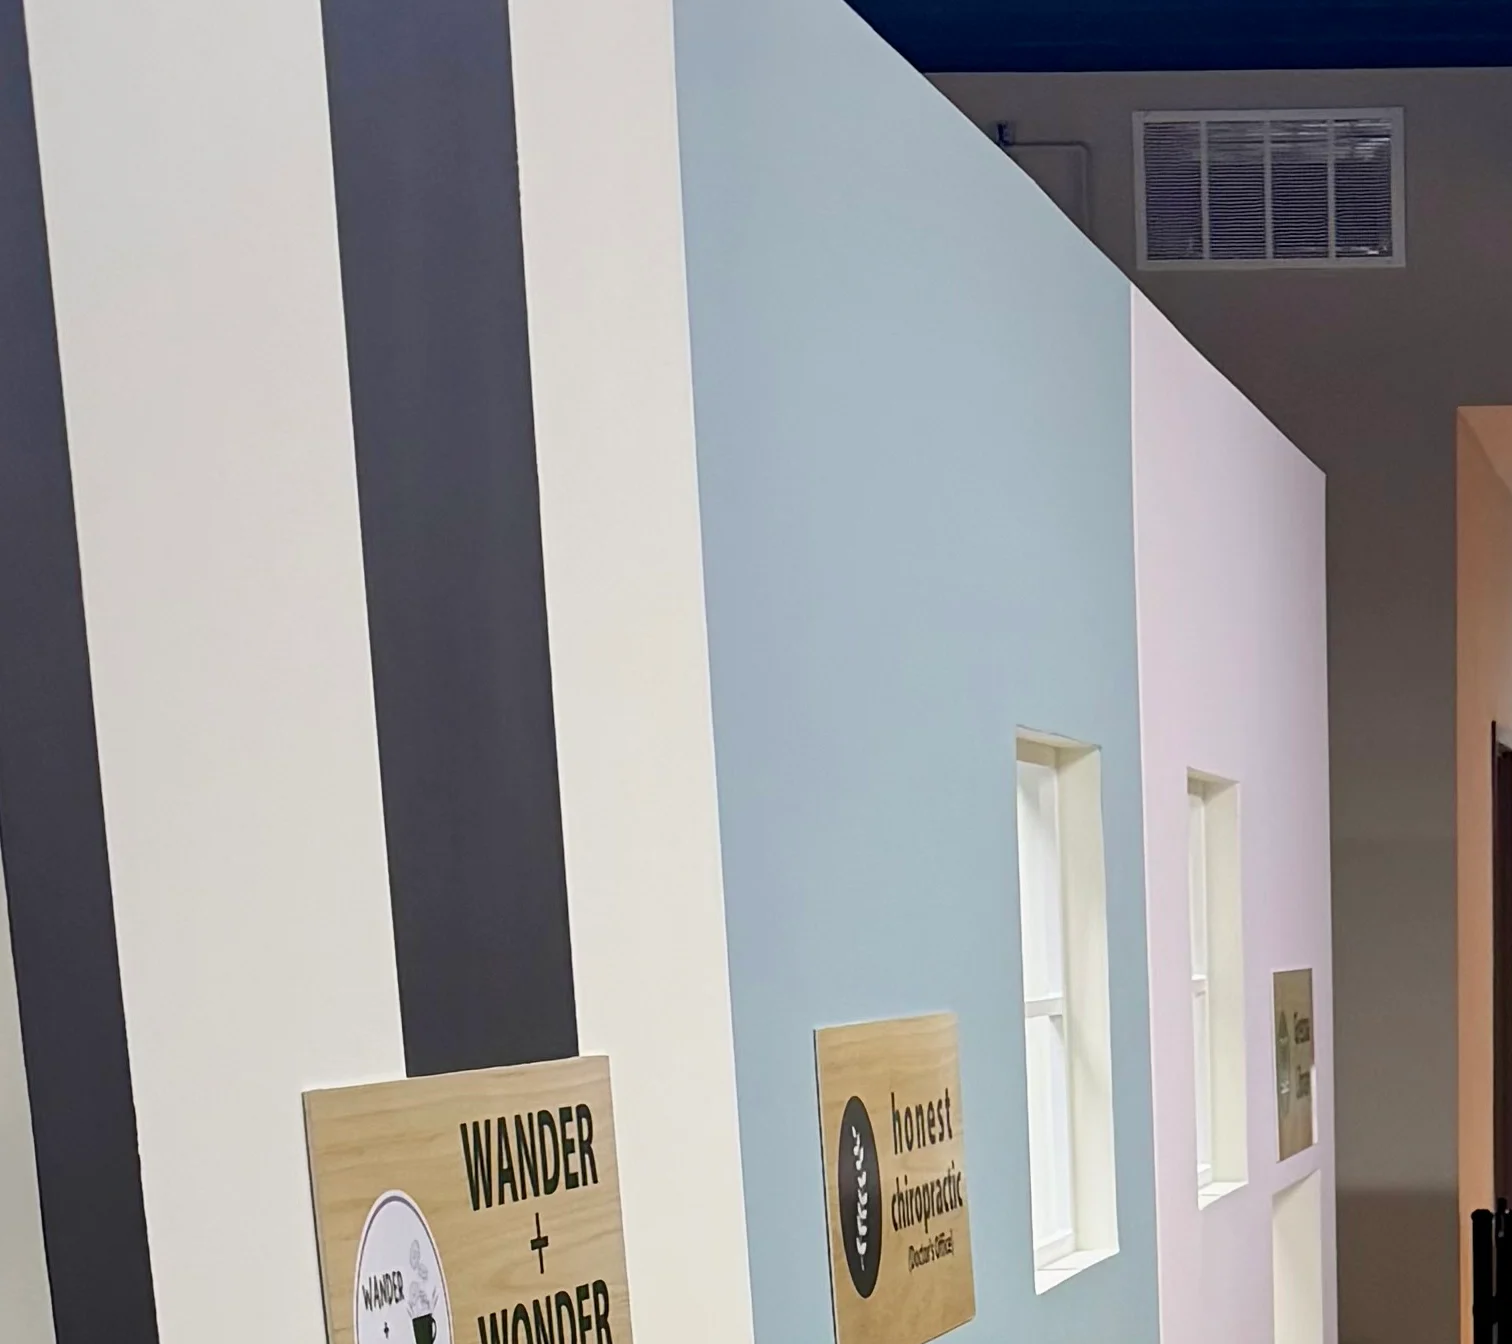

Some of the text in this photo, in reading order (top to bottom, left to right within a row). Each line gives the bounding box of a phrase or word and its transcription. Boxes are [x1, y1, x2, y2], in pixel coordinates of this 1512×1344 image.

[891, 1087, 953, 1155] honest
[460, 1103, 598, 1212] WANDER
[891, 1159, 963, 1234] chiropractic
[530, 1212, 549, 1274] +
[362, 1270, 405, 1311] WANDER
